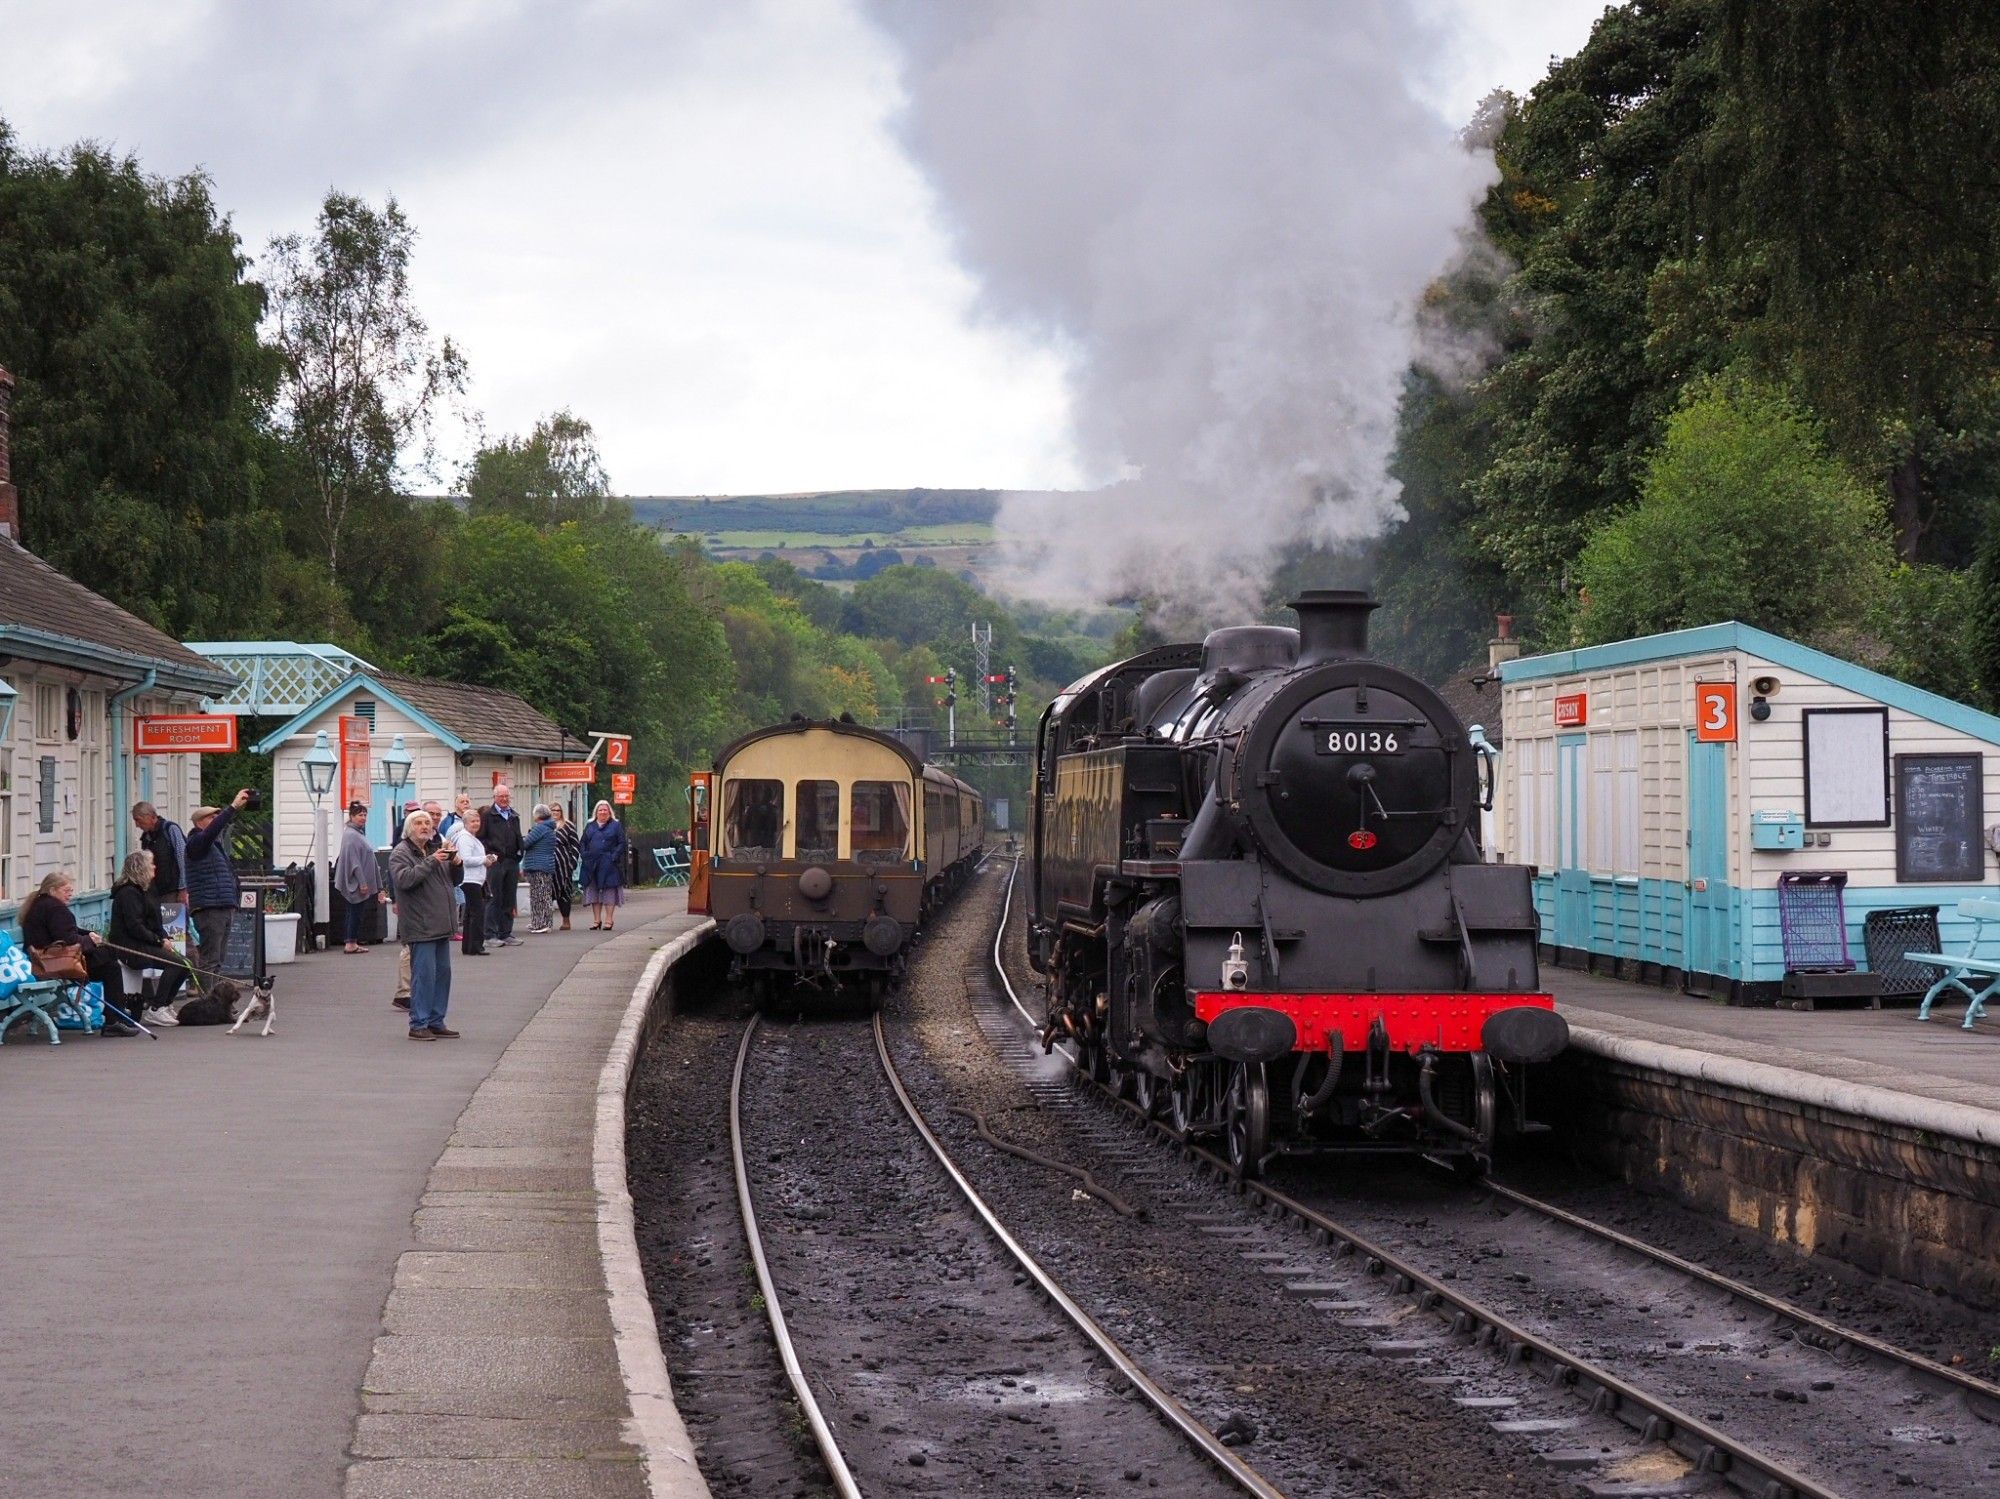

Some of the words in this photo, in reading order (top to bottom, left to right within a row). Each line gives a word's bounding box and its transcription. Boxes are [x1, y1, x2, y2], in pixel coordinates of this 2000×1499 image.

[1704, 694, 1728, 731] 3
[147, 725, 221, 734] REFRESHMENT
[169, 735, 201, 743] ROOM
[611, 741, 623, 763] 2
[1328, 732, 1398, 752] 80136
